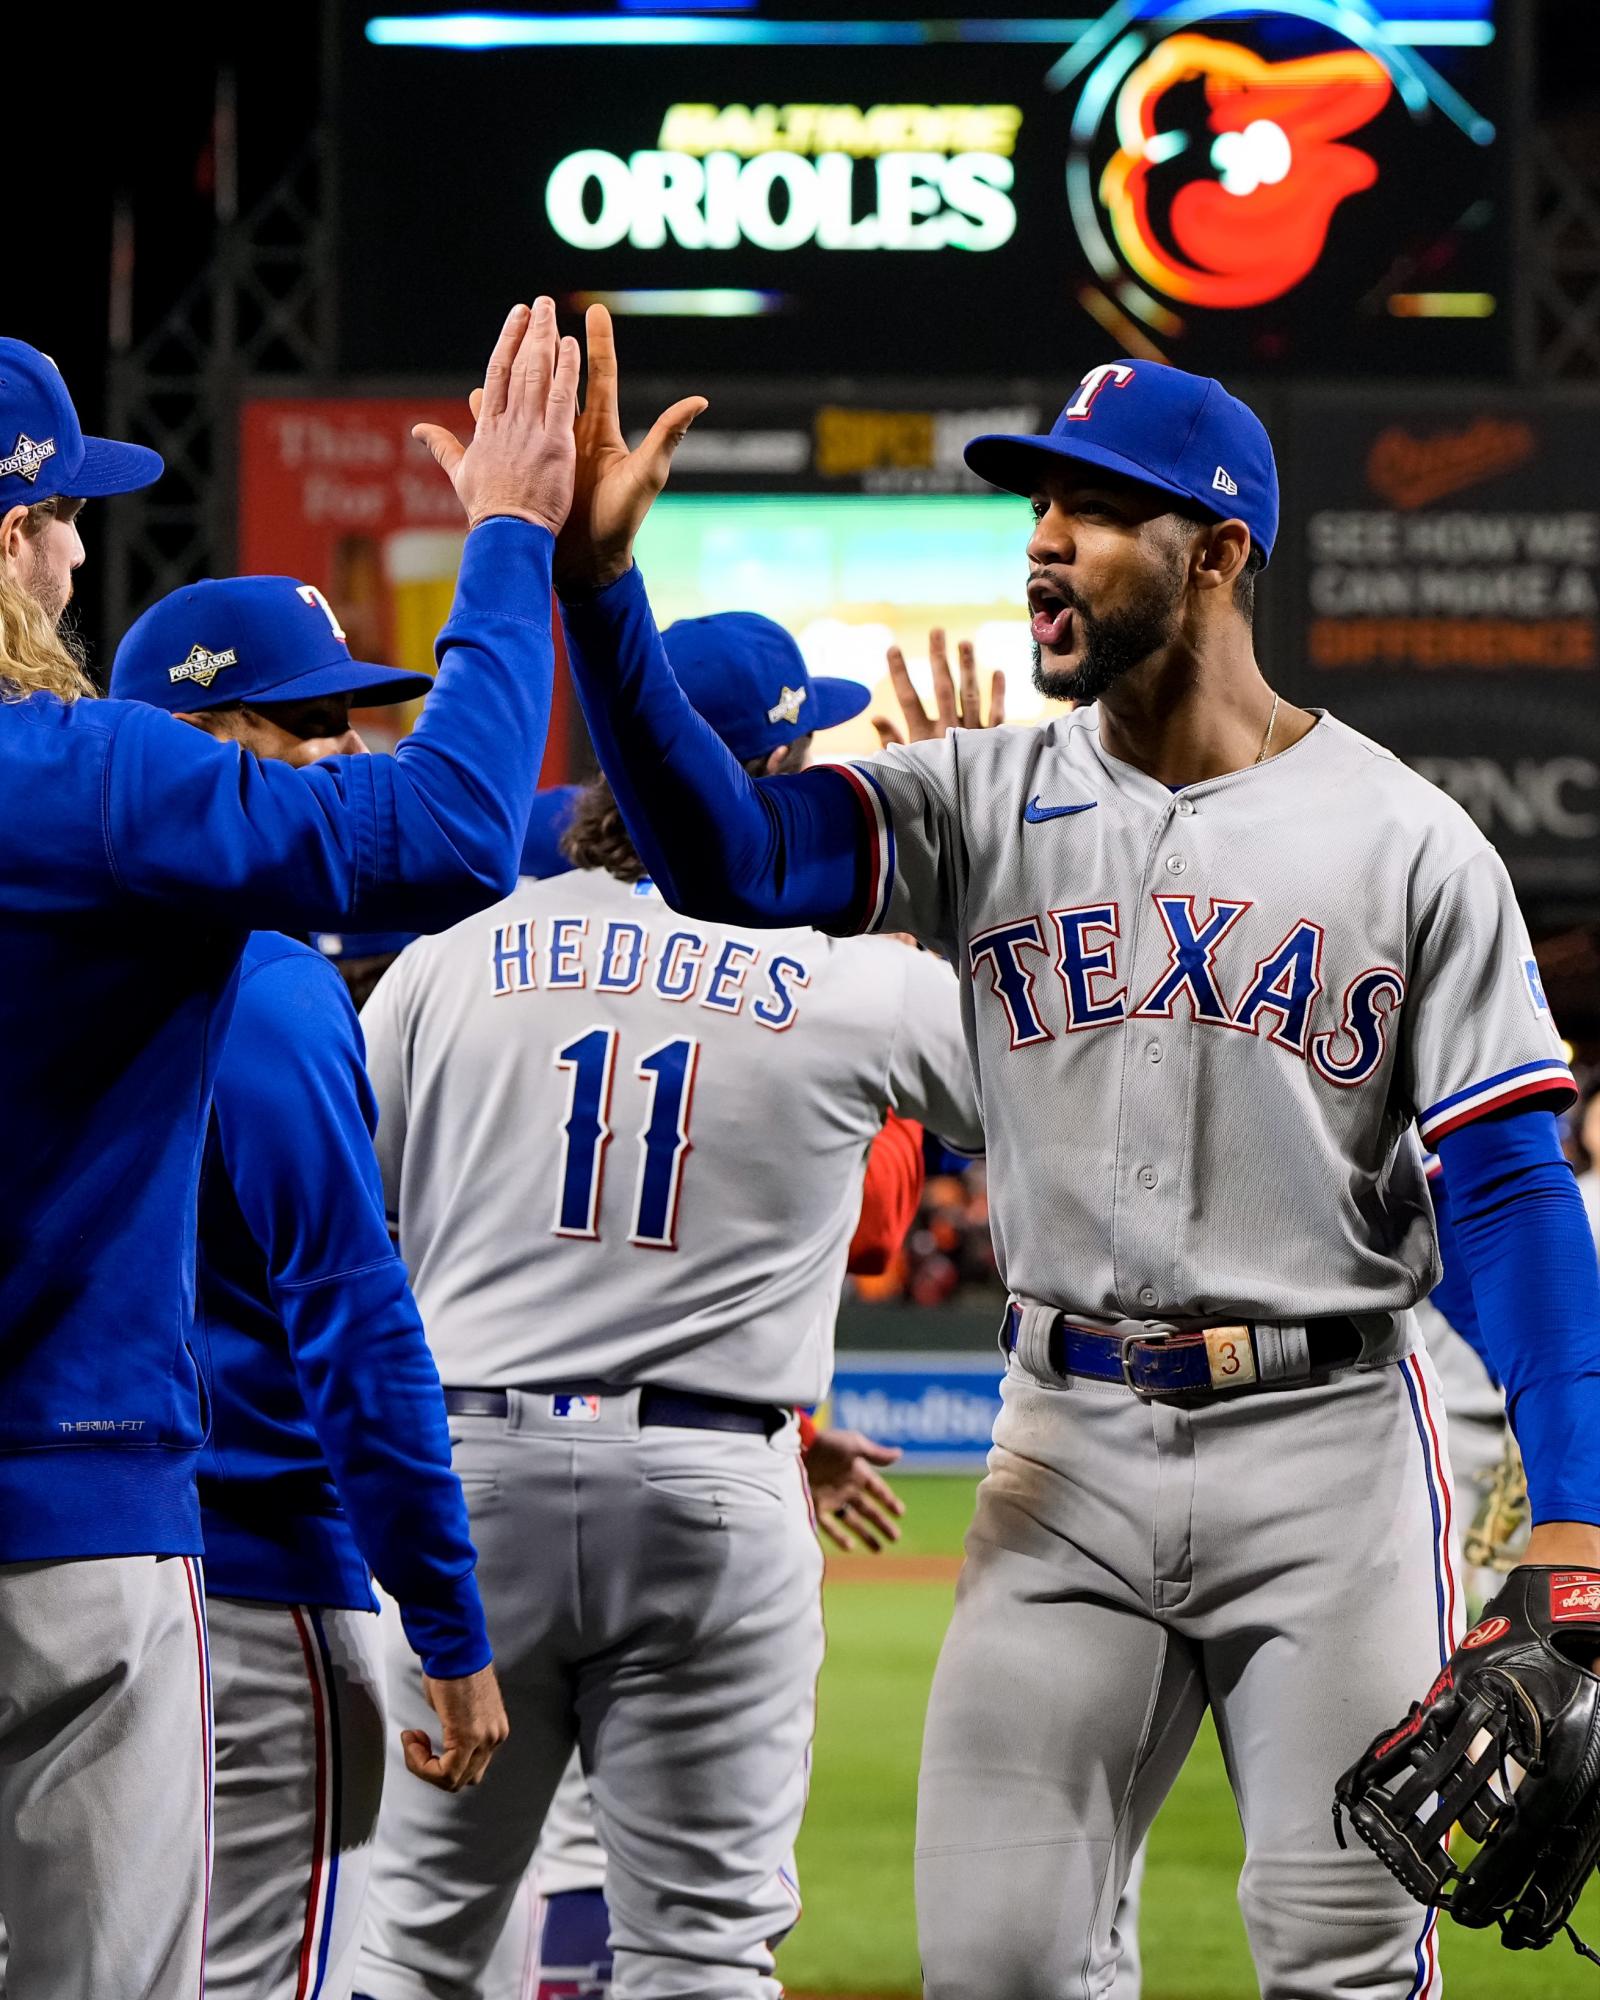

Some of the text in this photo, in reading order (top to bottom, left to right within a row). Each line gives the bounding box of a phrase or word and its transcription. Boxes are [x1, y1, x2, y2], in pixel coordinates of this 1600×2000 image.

[657, 103, 1023, 157] BALTIMORE
[545, 149, 1017, 251] ORIOLES
[1066, 364, 1135, 421] T
[169, 651, 236, 682] POSTSEASON
[489, 916, 811, 1032] HEDGES
[968, 894, 1405, 1088] TEXAS
[551, 1023, 700, 1252] 11
[1218, 1341, 1241, 1376] 3
[58, 1420, 146, 1433] THERMA-FIT
